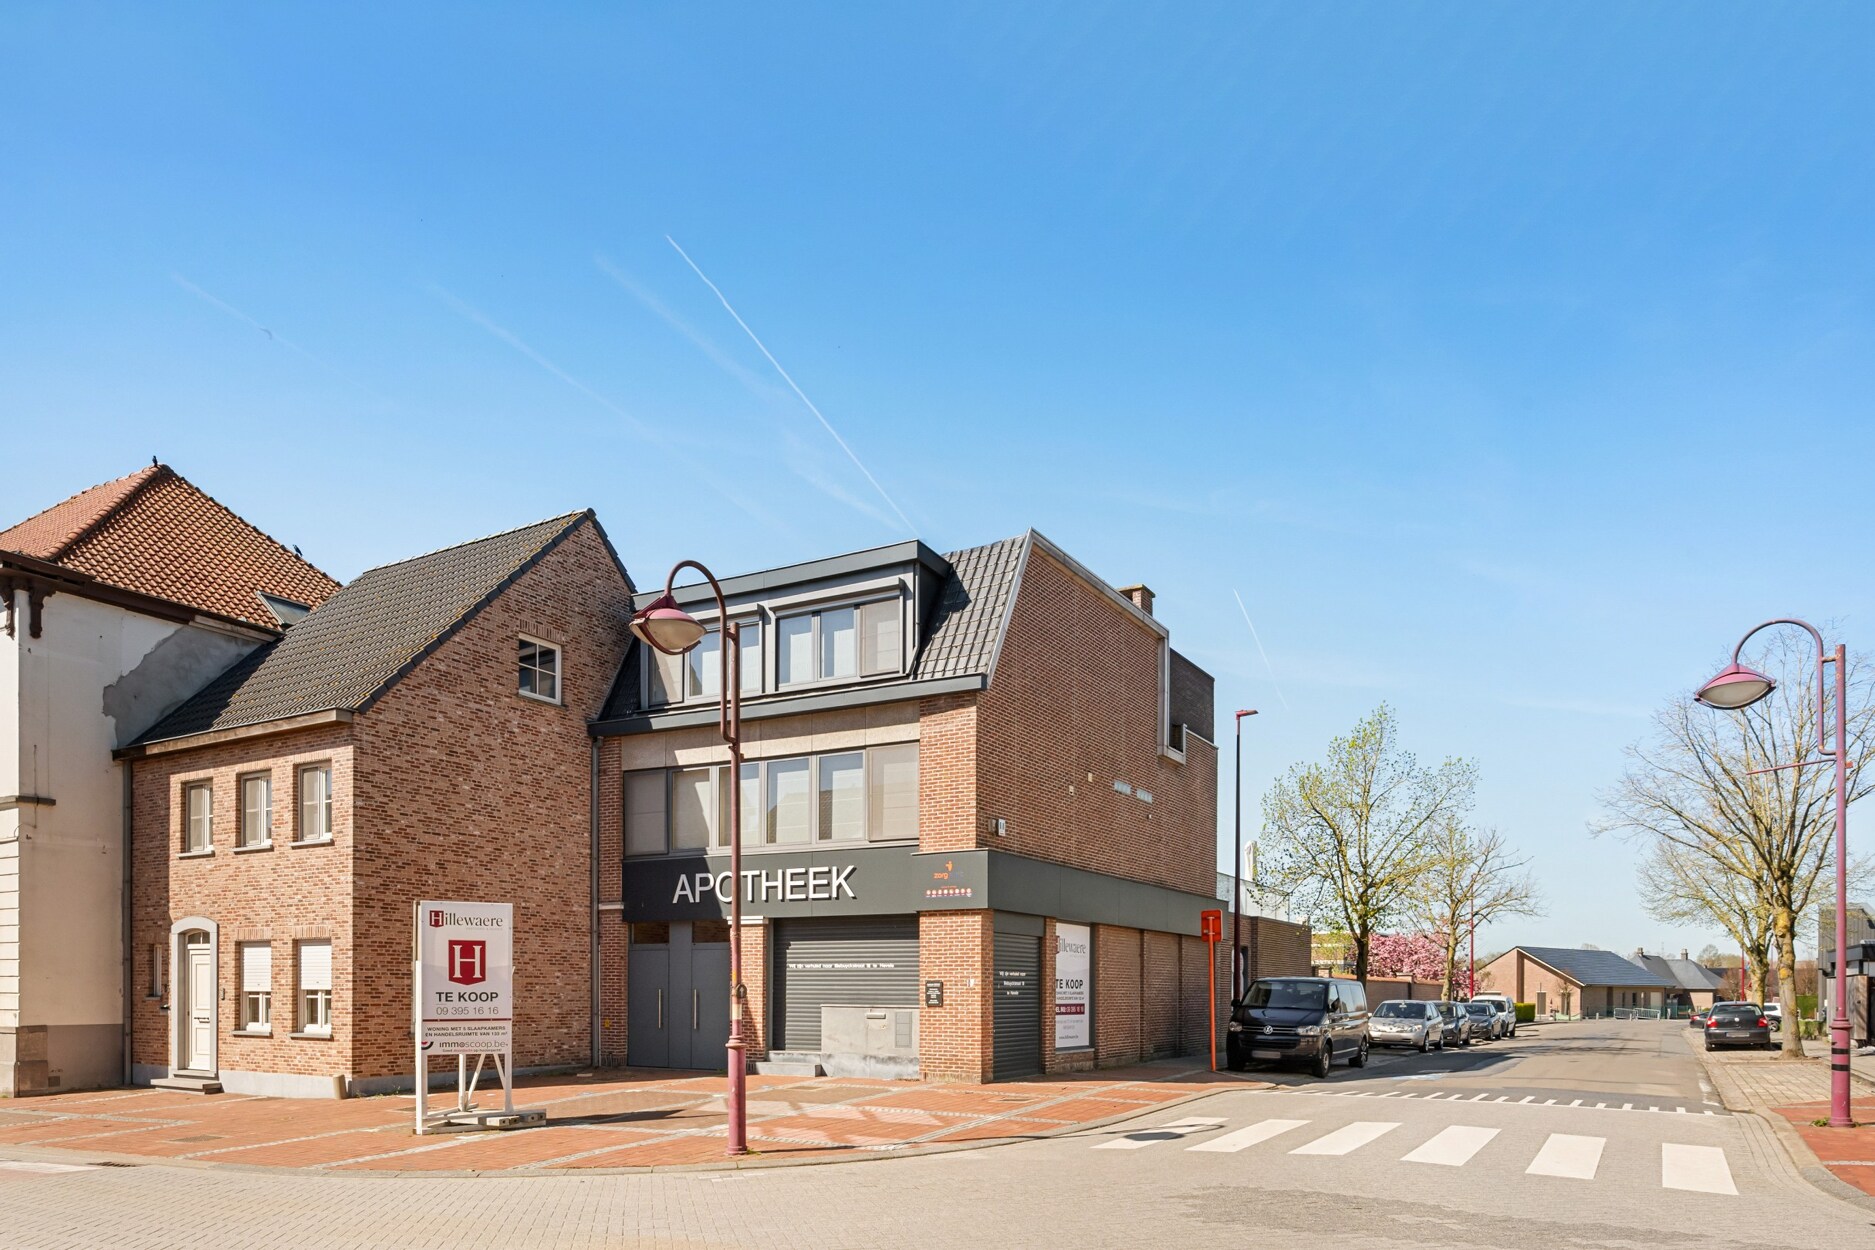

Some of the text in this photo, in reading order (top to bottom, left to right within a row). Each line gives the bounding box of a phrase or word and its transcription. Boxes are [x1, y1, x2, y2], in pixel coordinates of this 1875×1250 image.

[672, 865, 856, 904] APOTHEEK
[430, 911, 503, 927] Hillewaere
[452, 944, 483, 979] H
[1065, 979, 1084, 990] KOOP
[436, 991, 499, 1002] TE KOOP
[436, 1006, 499, 1016] 09 395 16 16
